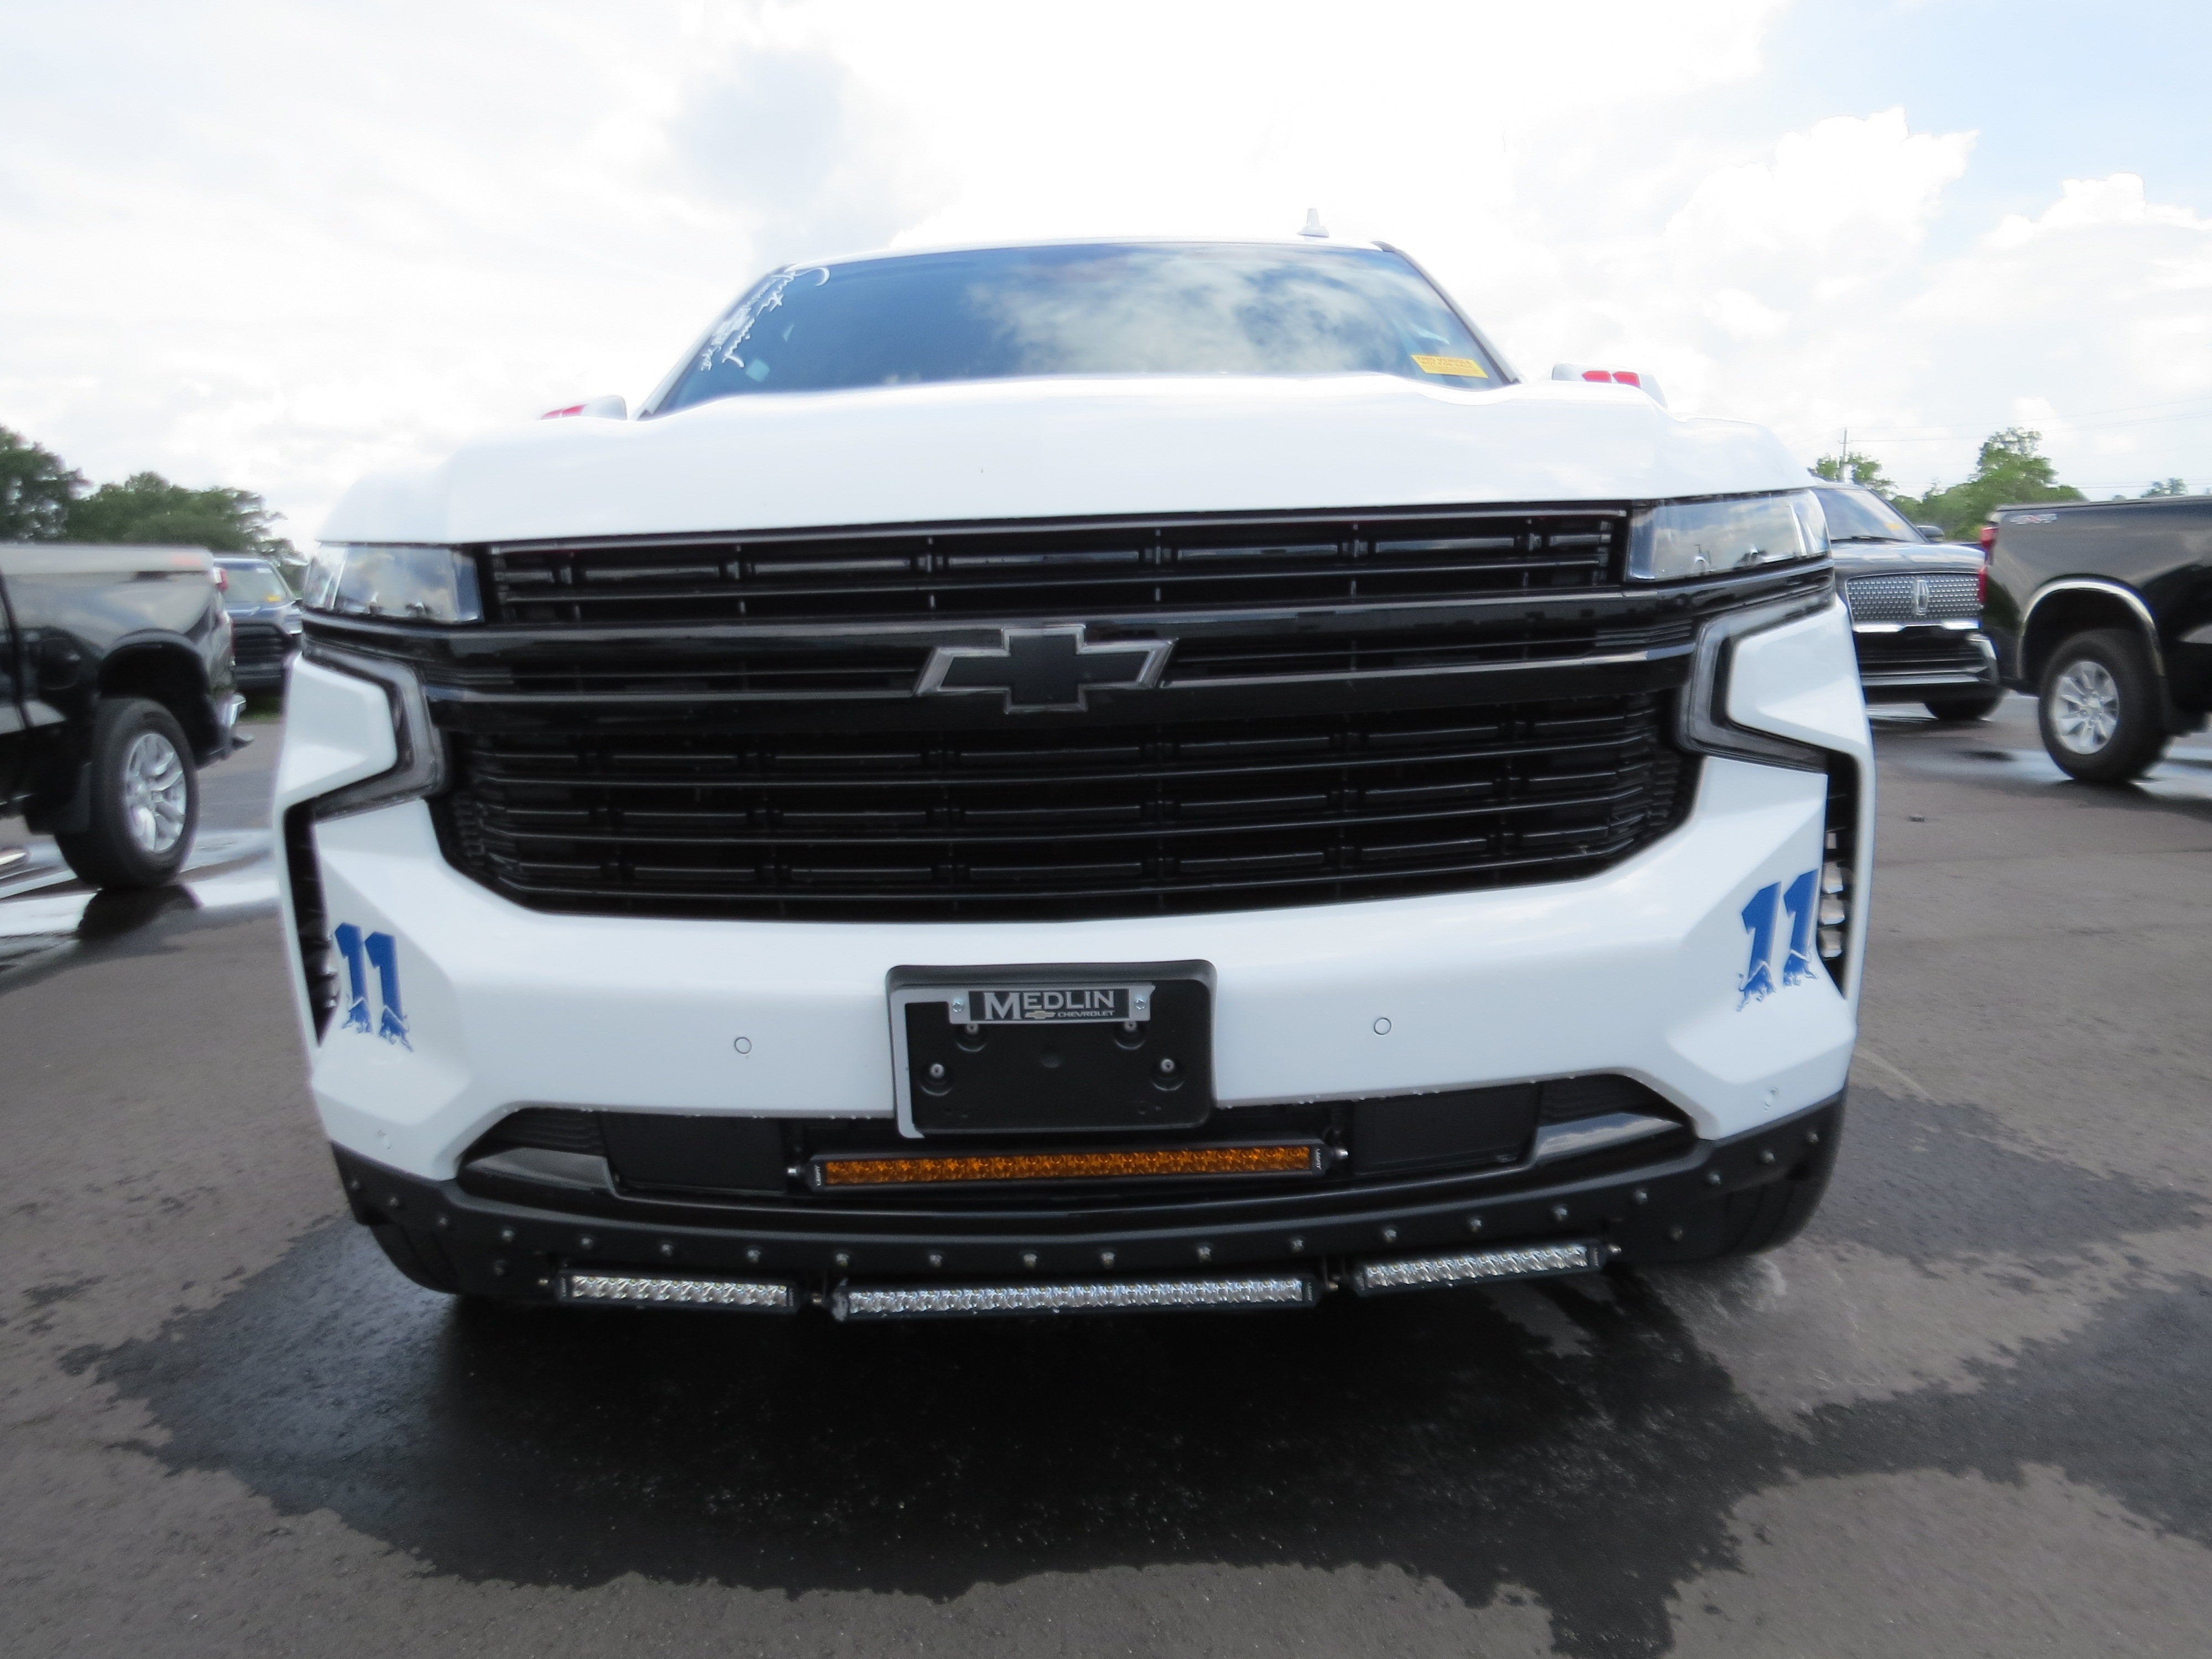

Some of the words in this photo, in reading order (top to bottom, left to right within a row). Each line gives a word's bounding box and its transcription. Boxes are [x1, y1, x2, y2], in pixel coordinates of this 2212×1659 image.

[1736, 868, 1819, 1012] 11
[335, 922, 414, 1052] 11
[983, 990, 1115, 1020] MEDLIN
[1057, 1010, 1115, 1018] CHEVROLET
